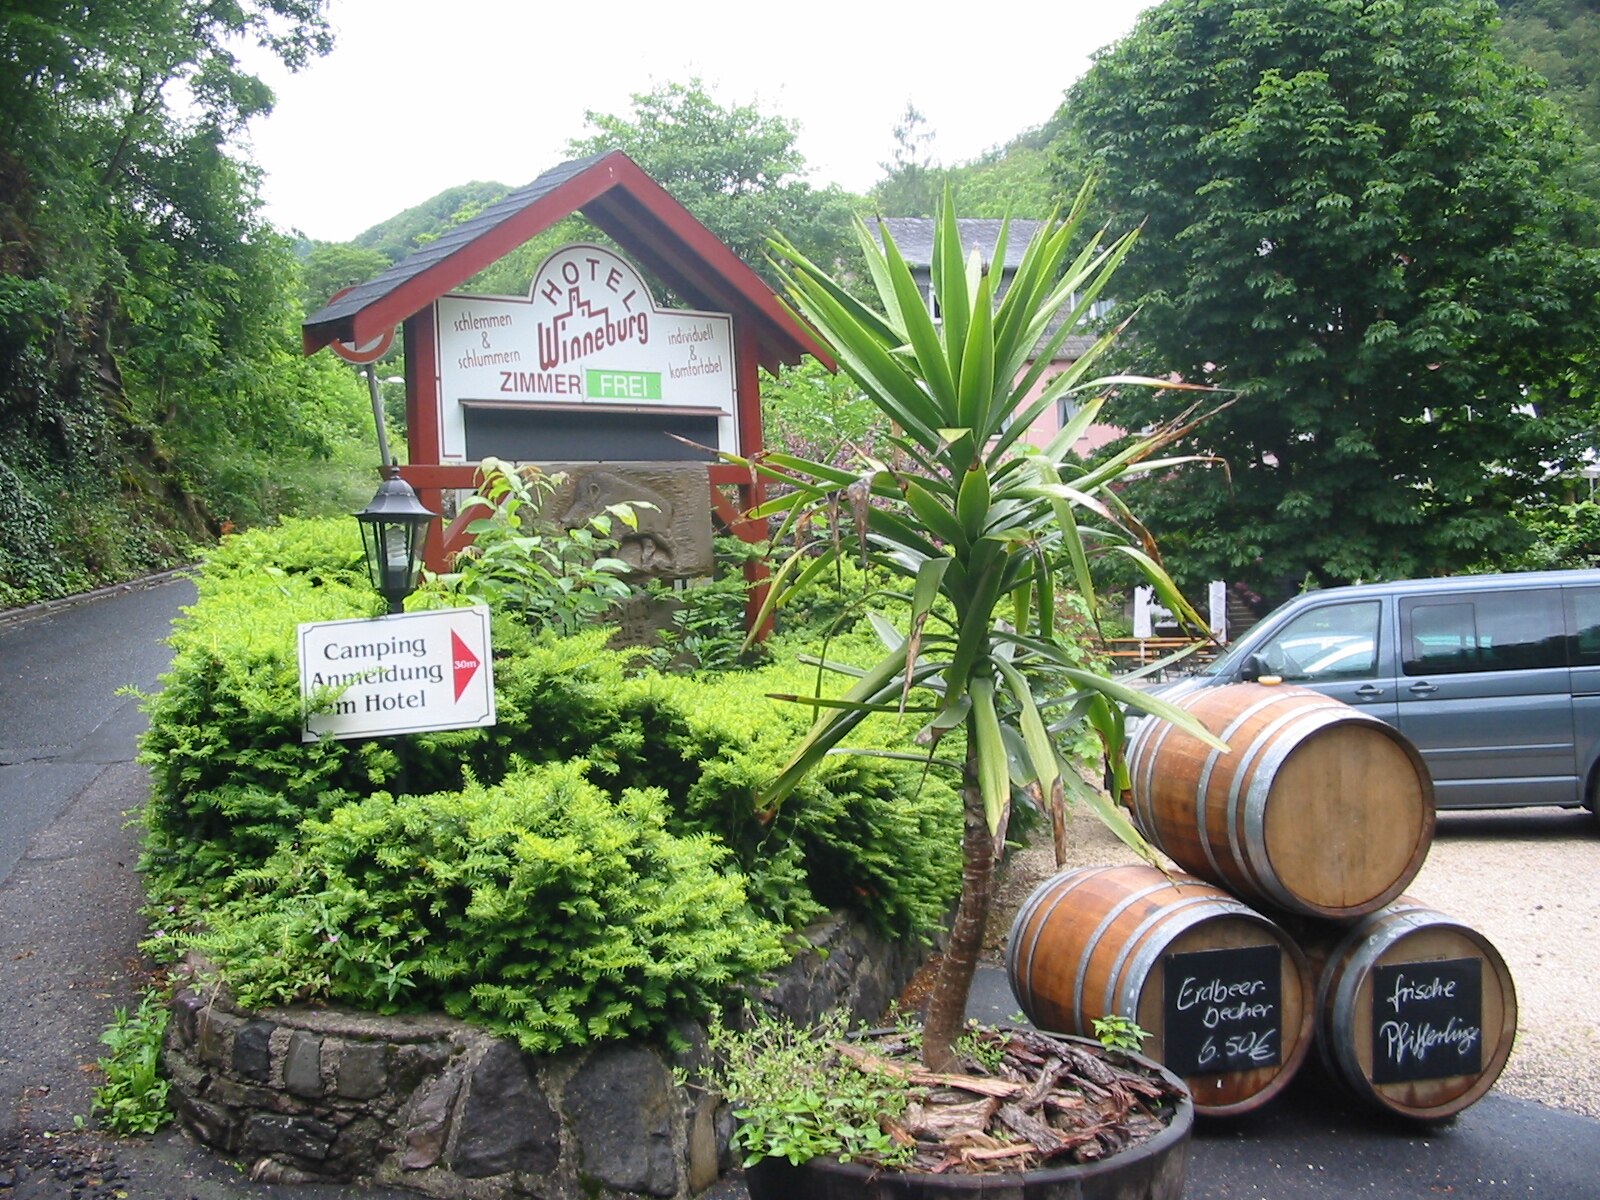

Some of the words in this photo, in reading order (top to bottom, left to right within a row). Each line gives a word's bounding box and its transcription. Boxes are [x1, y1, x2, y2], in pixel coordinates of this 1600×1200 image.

[541, 258, 637, 312] HOTEL
[454, 312, 513, 331] schlemmen
[481, 332, 491, 349] &
[537, 312, 649, 372] Winneburg
[667, 323, 715, 346] individuell
[458, 350, 521, 369] schlummern
[688, 345, 698, 361] &
[668, 355, 723, 380] komfortabel
[500, 371, 582, 395] ZIMMER
[600, 374, 649, 398] FREI
[323, 636, 428, 661] Camping
[311, 663, 444, 690] Anmeldung
[454, 659, 477, 670] 30m
[366, 690, 427, 713] Hotel
[1386, 973, 1457, 1013] frische
